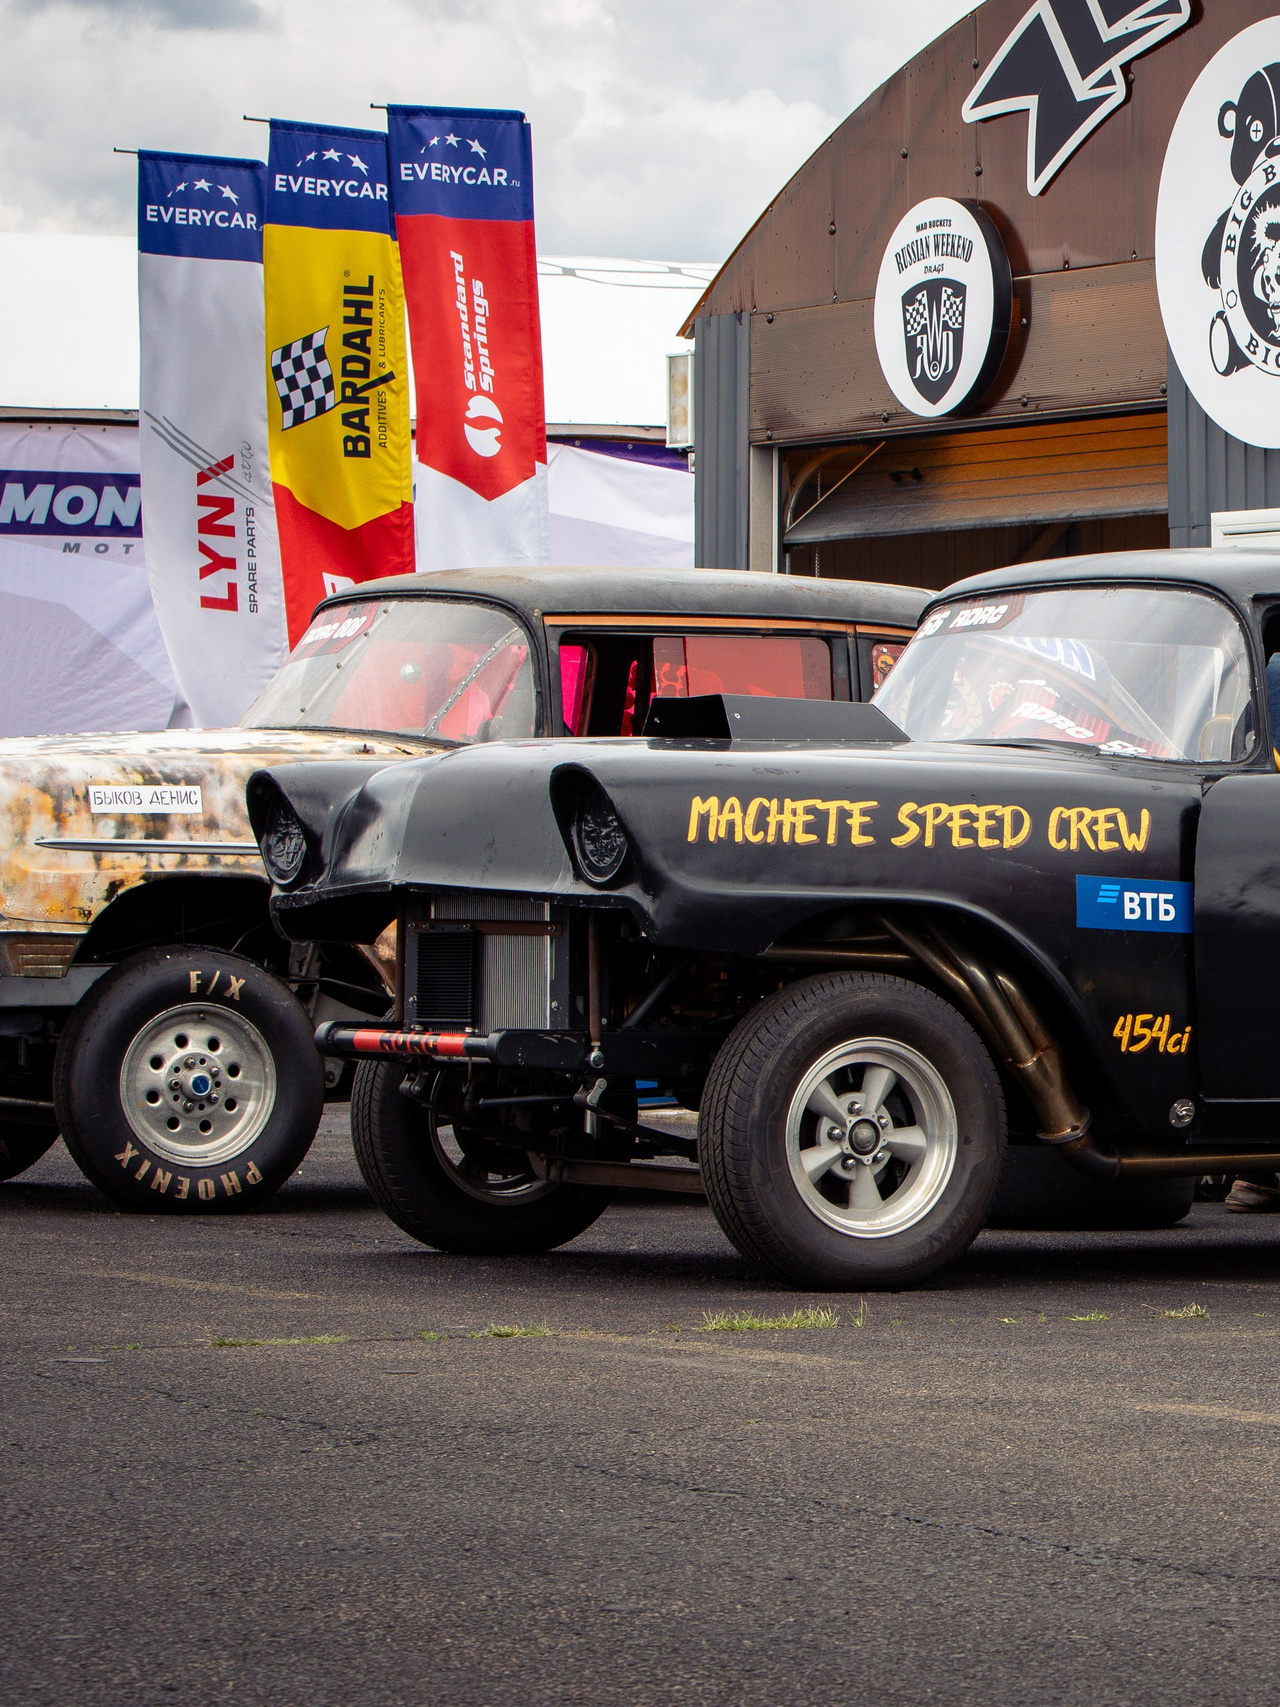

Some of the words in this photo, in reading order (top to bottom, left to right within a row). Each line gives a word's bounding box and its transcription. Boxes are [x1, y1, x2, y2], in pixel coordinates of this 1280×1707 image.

[916, 222, 929, 233] MAD
[929, 219, 952, 229] BUCKETS
[1224, 188, 1255, 255] BIG
[894, 235, 930, 275] RUSSIAN
[933, 233, 974, 263] WEEKEND
[924, 263, 945, 275] DRAGS
[378, 288, 386, 358] LUBRICANTS
[341, 275, 374, 459] BARDAHL
[378, 361, 387, 369] &
[378, 390, 388, 449] ADDITIVES
[196, 454, 238, 612] LYNX
[245, 507, 256, 558] PARTS
[248, 562, 259, 614] SPARE
[93, 791, 143, 806] БЫКОВ
[149, 790, 198, 806] ДЕНИС
[687, 795, 881, 846] MACHETE
[890, 802, 1032, 849] SPEED
[1048, 806, 1152, 853] CREW
[1123, 891, 1176, 922] ВТБ
[188, 970, 246, 1001] F/X
[1113, 1013, 1192, 1054] 454ci
[114, 1141, 263, 1201] PHOENIX
